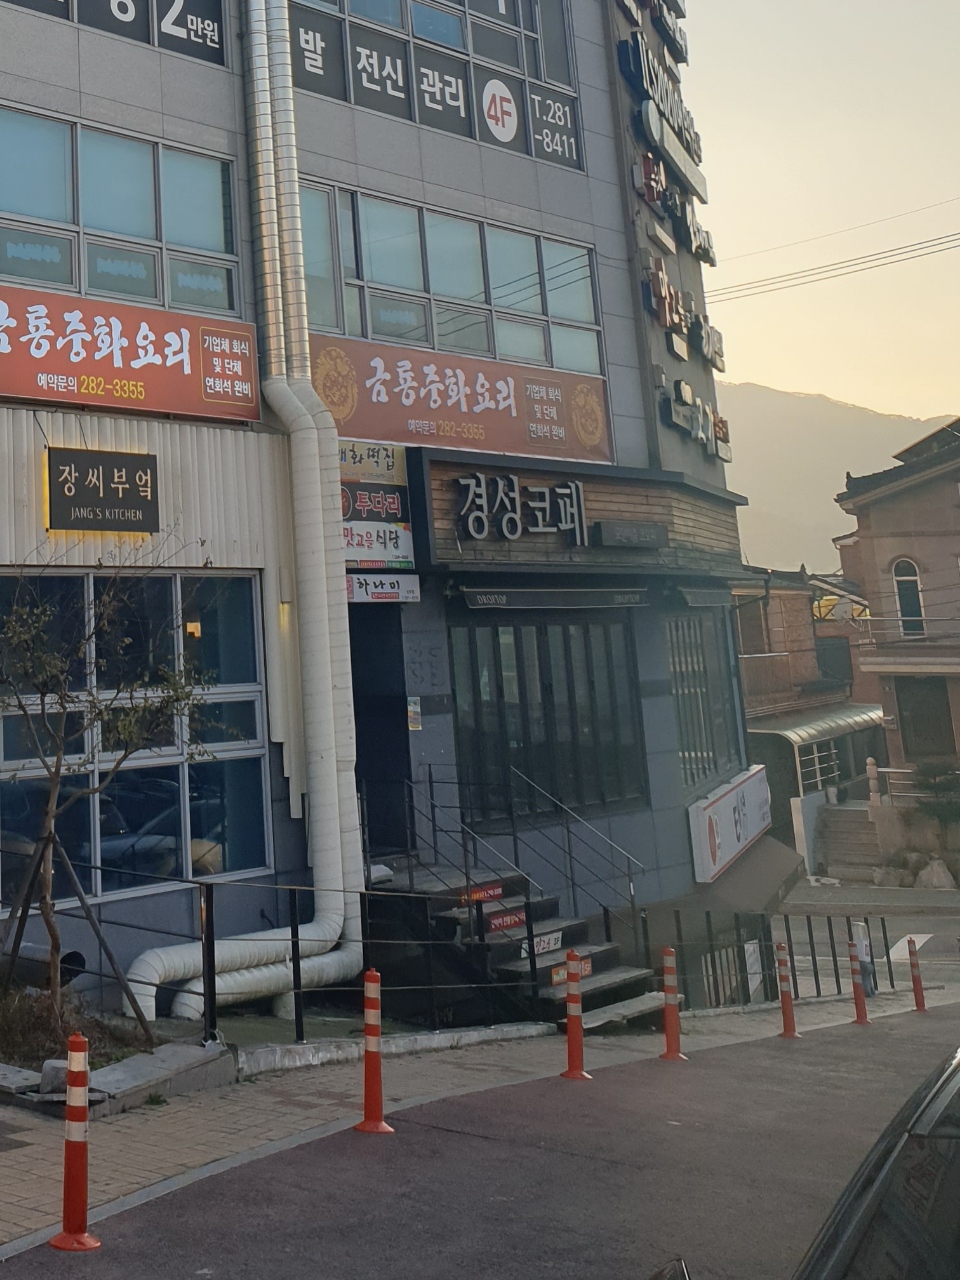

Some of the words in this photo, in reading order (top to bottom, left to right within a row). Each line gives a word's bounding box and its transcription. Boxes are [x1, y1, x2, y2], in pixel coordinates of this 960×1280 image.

[298, 27, 325, 76] 발
[356, 45, 406, 99] 전신
[420, 65, 466, 118] 관리
[486, 92, 513, 128] 4F
[531, 93, 572, 129] T.281
[534, 131, 577, 161] -8411
[203, 334, 230, 355] 기업체
[232, 337, 250, 357] 회식
[213, 358, 223, 373] 및
[224, 359, 243, 376] 단체
[37, 372, 78, 394] 예약문의
[80, 375, 145, 400] 282-3355
[205, 377, 232, 396] 연회석
[234, 380, 252, 398] 완비
[526, 384, 548, 400] 기업체
[548, 388, 562, 401] 회식
[533, 405, 542, 419] 및
[543, 406, 558, 421] 단체
[408, 419, 438, 437] 예약문의
[439, 420, 485, 440] 282-3355
[529, 423, 551, 439] 연회석
[551, 426, 566, 441] 완비
[58, 463, 152, 500] 장씨부엌
[105, 508, 143, 520] KITCHEN
[355, 491, 402, 518] 투다리
[458, 472, 589, 547] 경성코페
[356, 577, 401, 596] 하나미
[477, 594, 507, 604] DROPTOP
